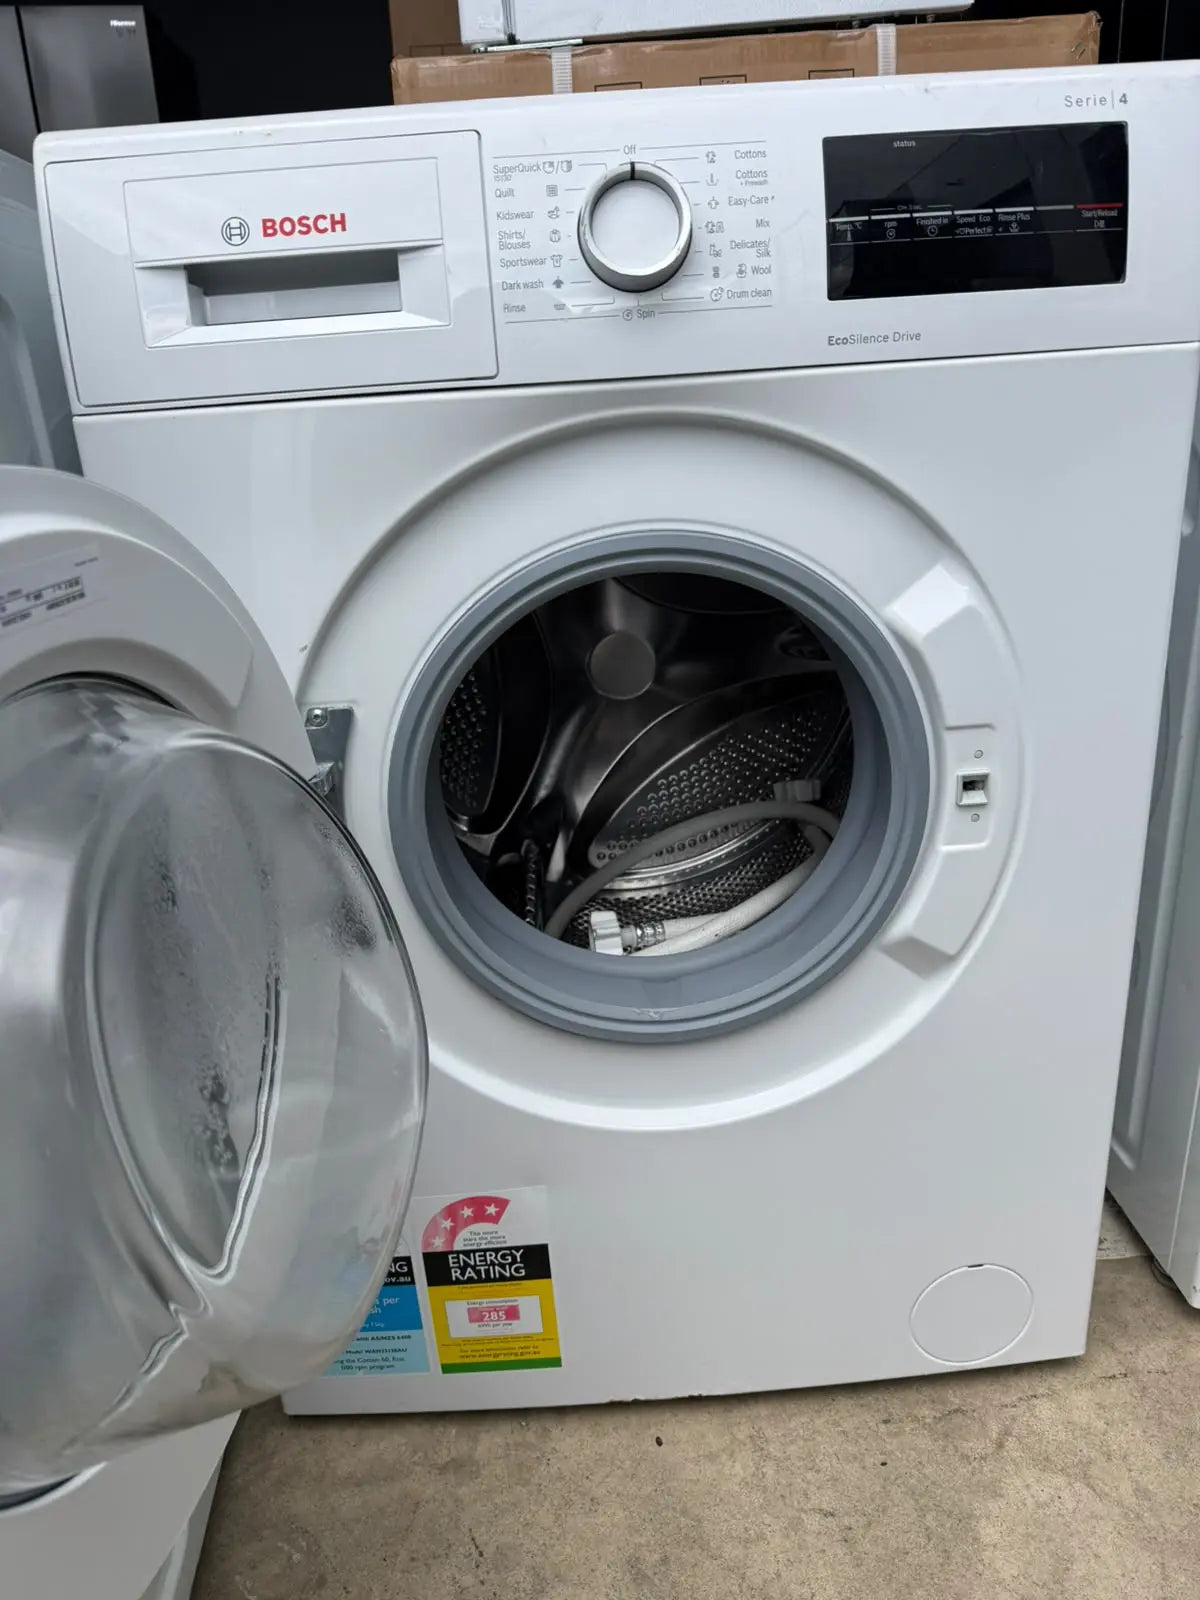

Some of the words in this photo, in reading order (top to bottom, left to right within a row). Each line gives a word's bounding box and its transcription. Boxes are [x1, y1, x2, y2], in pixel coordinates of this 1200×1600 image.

[1064, 94, 1107, 108] Serie
[1119, 92, 1128, 105] 4
[623, 144, 636, 155] Off
[893, 140, 916, 148] status
[734, 149, 767, 160] Cottons
[493, 160, 541, 175] SuperQuick
[735, 169, 768, 180] Cottons
[494, 187, 515, 198] Quilt
[496, 209, 534, 220] Kidswear
[956, 216, 976, 225] Speed
[978, 214, 991, 223] Eco
[998, 213, 1016, 222] Rinse
[1016, 212, 1031, 221] Plus
[261, 212, 347, 238] BOSCH
[756, 218, 770, 229] Mix
[884, 221, 898, 229] rpm
[916, 216, 941, 226] Finished
[497, 227, 526, 240] Shirts/
[965, 226, 984, 235] Perfect
[498, 240, 531, 251] Blouses
[729, 237, 771, 250] Delicates/
[756, 247, 771, 258] Silk
[499, 257, 547, 269] Sportswear
[751, 264, 772, 276] Wool
[501, 279, 521, 291] Dark
[522, 279, 544, 289] wash
[726, 289, 749, 300] Drum
[750, 288, 772, 298] clean
[503, 303, 526, 313] Rinse
[636, 308, 656, 320] Spin
[827, 333, 890, 347] EcoSilence
[892, 331, 922, 343] Drive
[447, 1249, 524, 1268] ENERGY
[450, 1263, 526, 1281] RATING
[382, 1297, 401, 1307] per
[482, 1311, 507, 1322] 285
